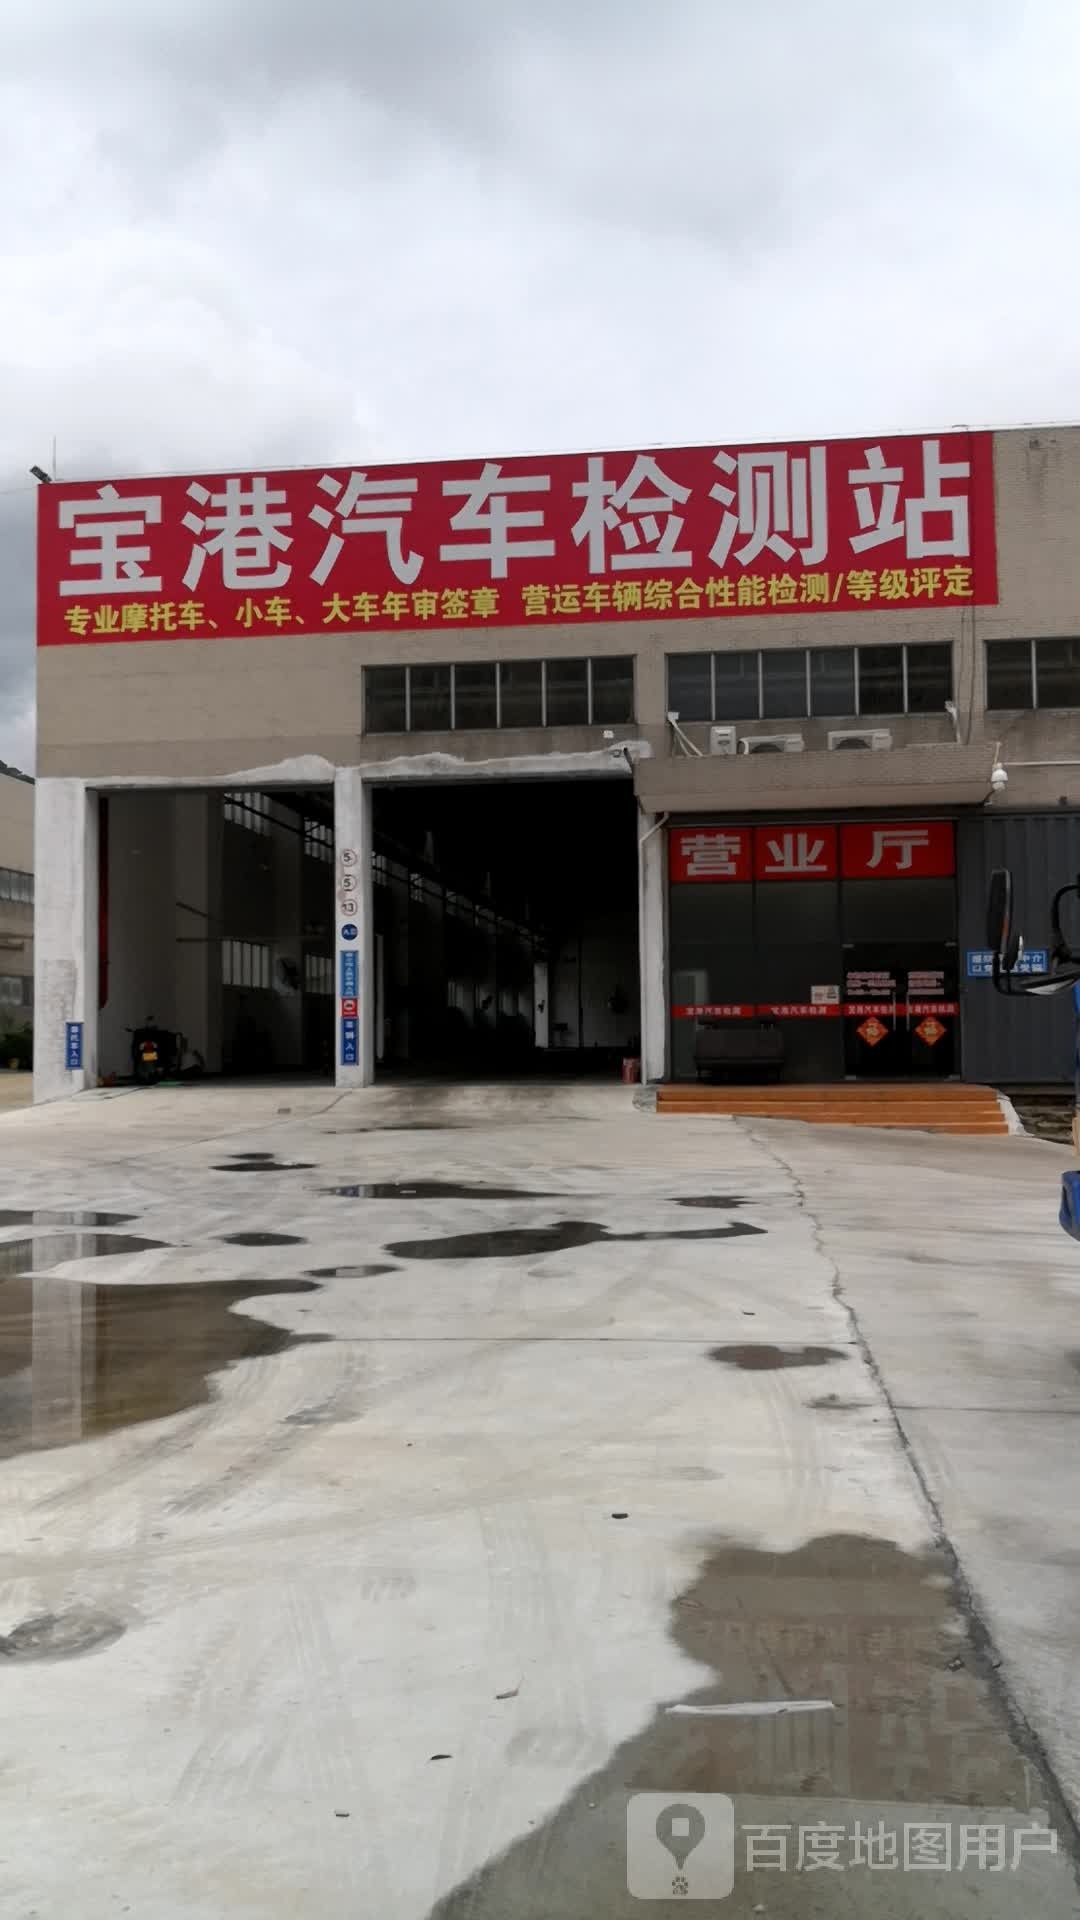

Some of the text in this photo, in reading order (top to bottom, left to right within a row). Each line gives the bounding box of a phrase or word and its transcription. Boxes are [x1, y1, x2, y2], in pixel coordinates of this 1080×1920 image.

[57, 439, 971, 597] 宝港汽车检测站
[63, 565, 975, 637] 专业摩托车、小车、大车年审签章 营运车辆综合性能检测/等级评定
[680, 828, 929, 877] 营业厅
